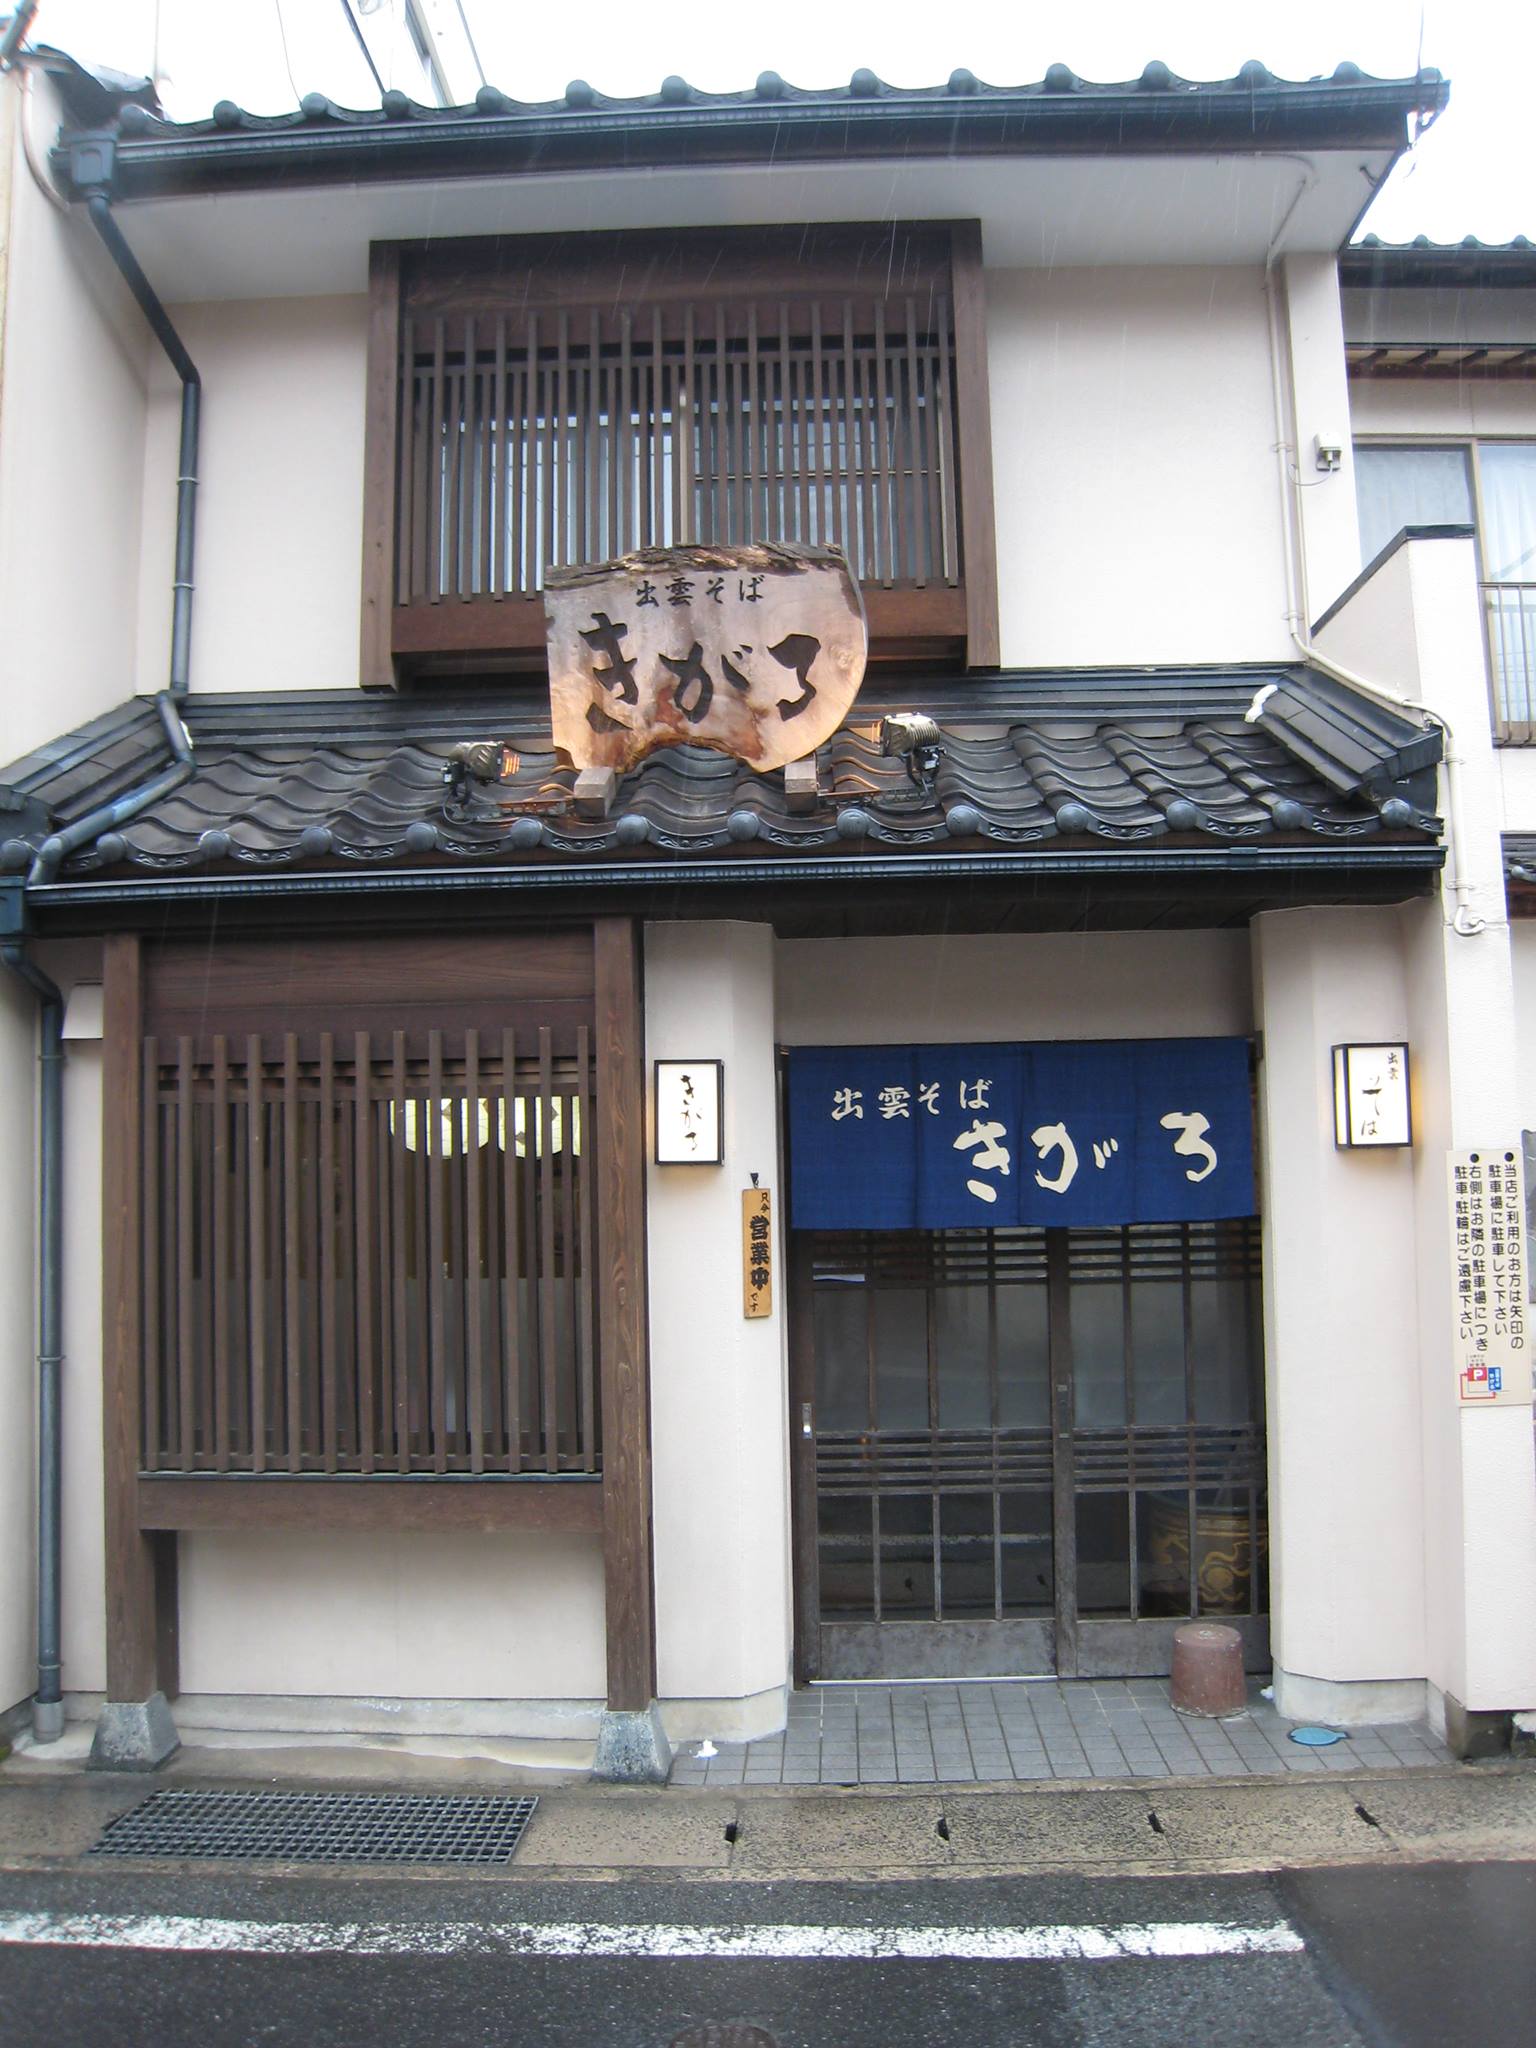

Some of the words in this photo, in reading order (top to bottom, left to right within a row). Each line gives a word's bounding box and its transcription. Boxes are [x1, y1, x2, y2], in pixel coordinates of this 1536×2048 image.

[635, 573, 766, 608] 出雲そば
[830, 1078, 993, 1121] 出雲そば
[1488, 1164, 1508, 1336] 駐車場に駐車して下さい
[1503, 1164, 1525, 1350] 当店ご利用のお方は矢印の
[1473, 1369, 1484, 1380] P
